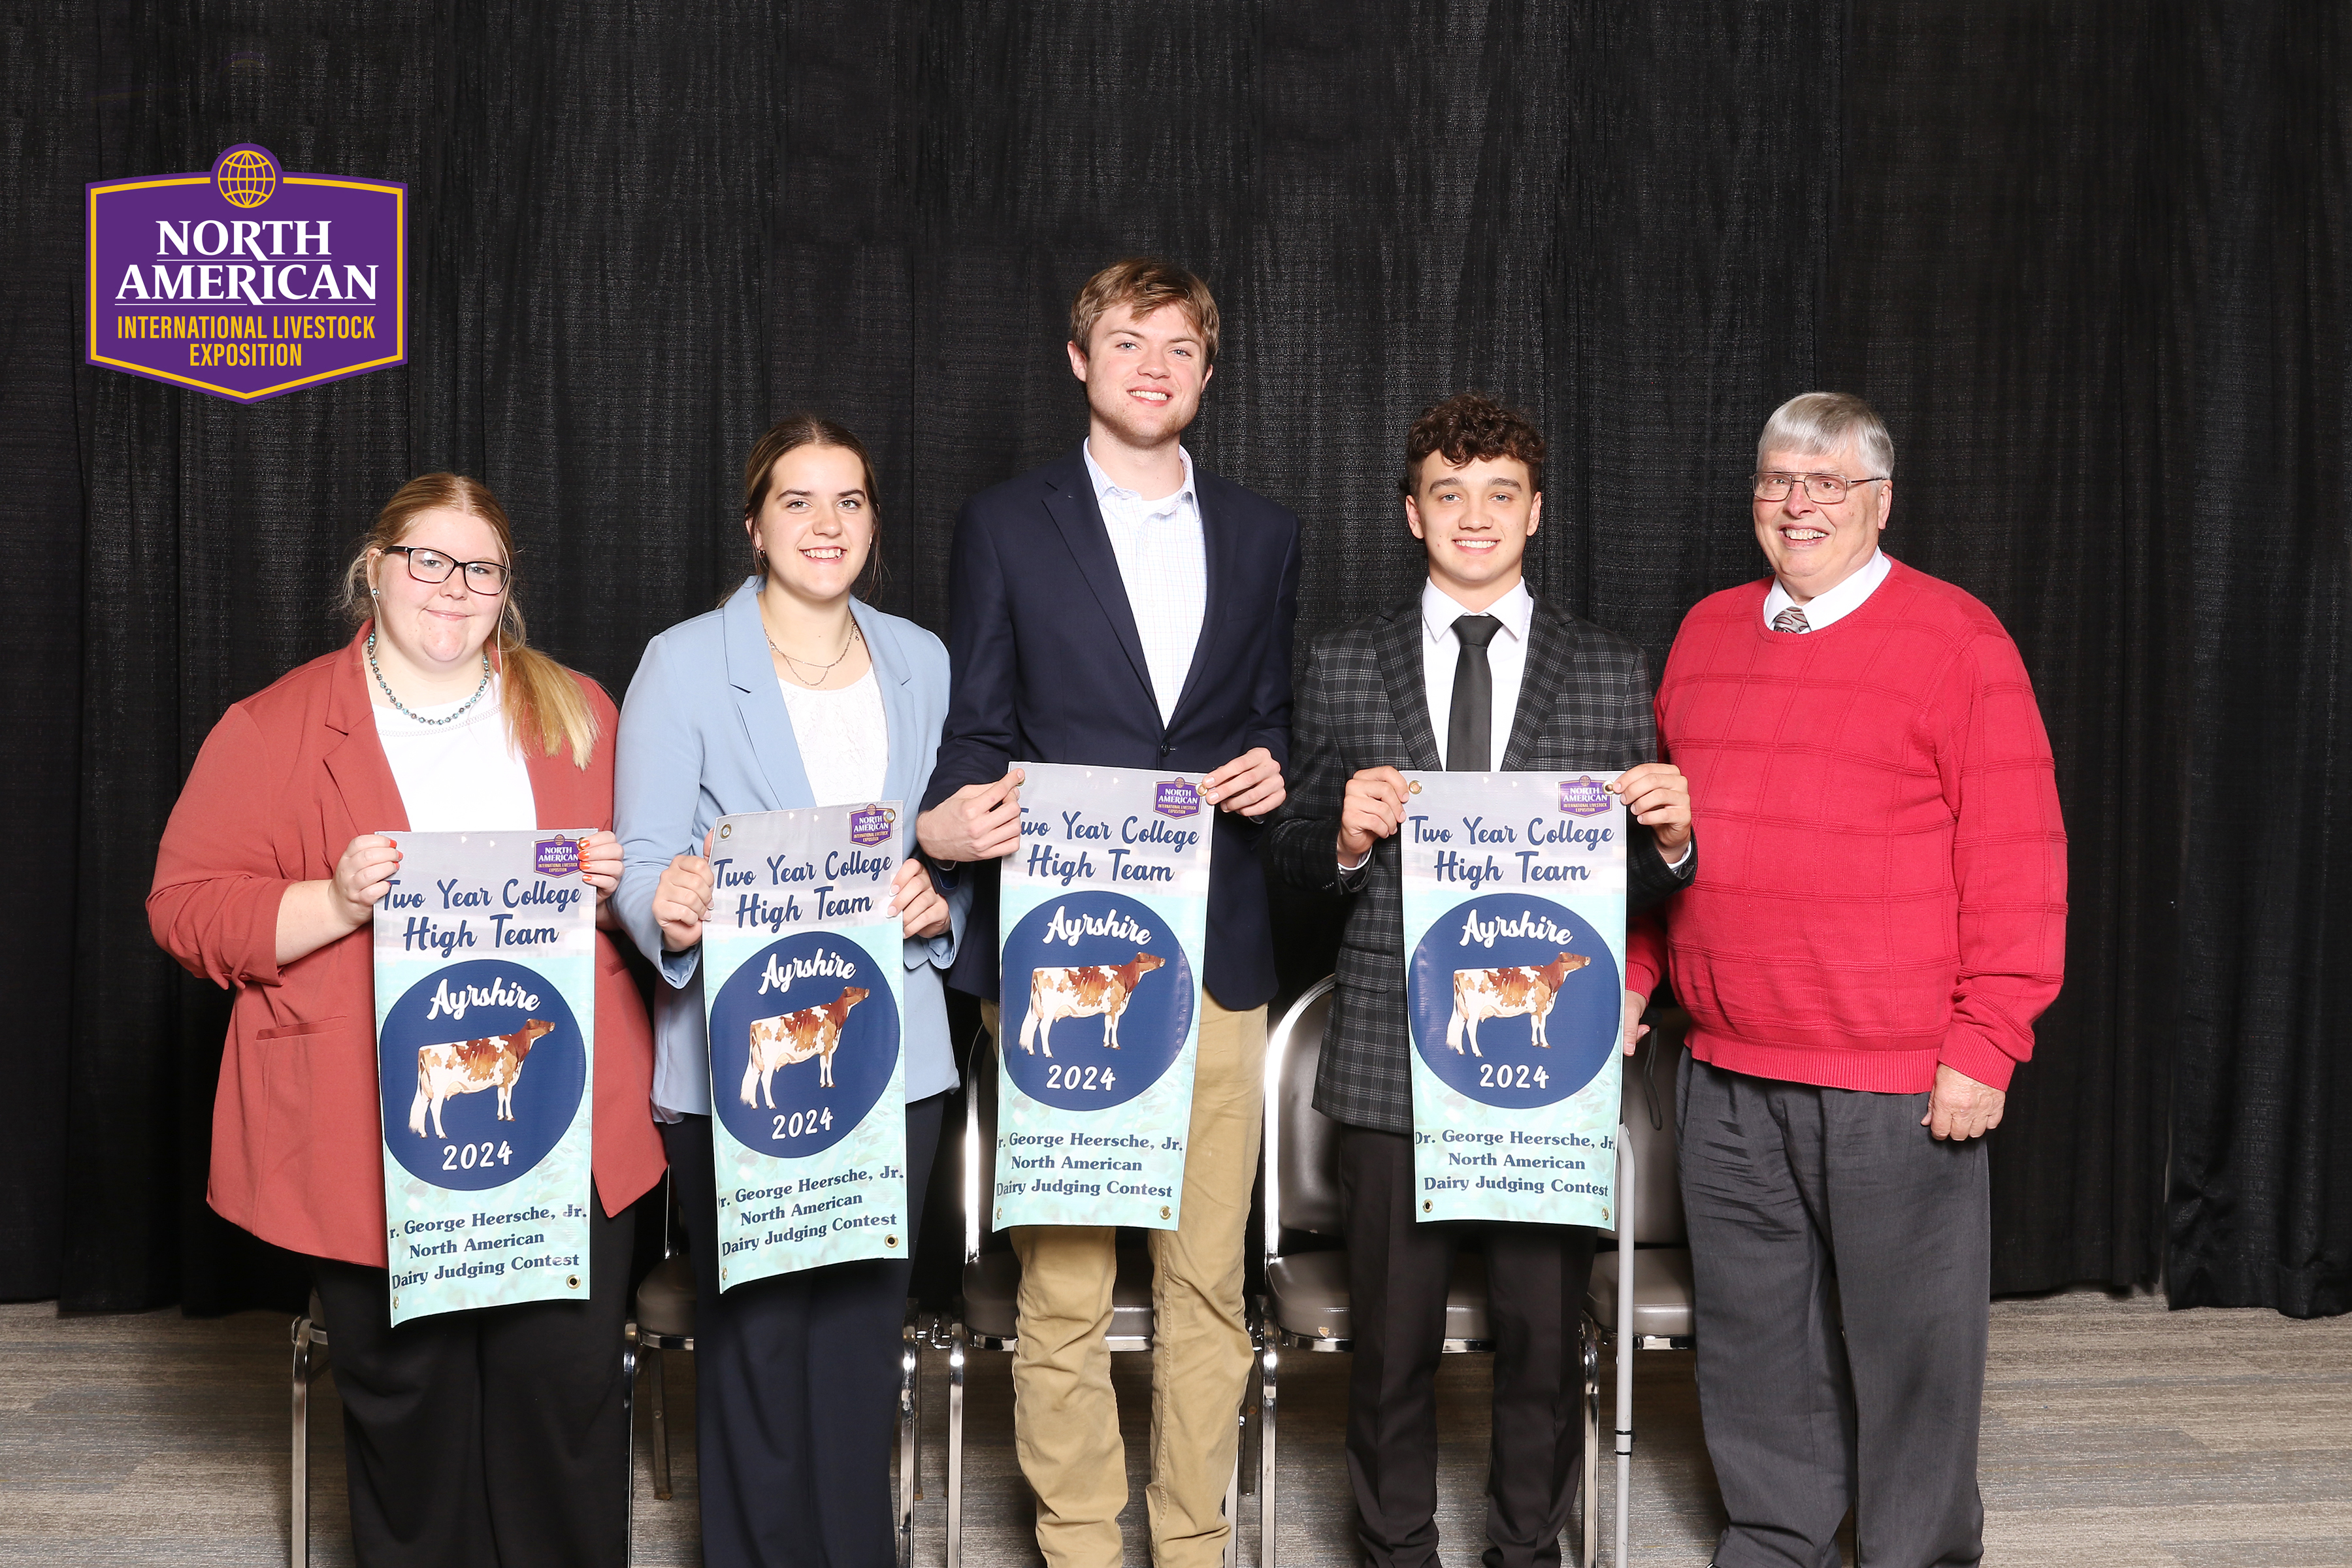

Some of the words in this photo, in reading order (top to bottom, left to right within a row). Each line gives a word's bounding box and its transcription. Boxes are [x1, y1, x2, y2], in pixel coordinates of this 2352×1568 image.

[1158, 795, 1198, 804] AMERICAN
[854, 823, 889, 832] AMERICAN
[859, 815, 882, 824] NORTH
[1062, 810, 1112, 840] Year
[1122, 815, 1200, 853] College
[1409, 815, 1453, 843] Two
[1463, 816, 1517, 845] Year
[1527, 817, 1614, 851] College
[713, 858, 757, 889] Two
[767, 855, 817, 885] Year
[825, 851, 893, 881] College
[1027, 844, 1096, 887] High
[1108, 848, 1175, 882] Team
[1434, 851, 1503, 889] High
[1515, 851, 1592, 883] Team
[383, 879, 426, 911] Two
[436, 879, 493, 909] Year
[502, 879, 582, 912] College
[736, 893, 803, 933] High
[814, 886, 874, 920] Team
[403, 917, 478, 958] High
[490, 913, 560, 948] Team
[1043, 906, 1152, 947] Ayrshire
[1459, 909, 1574, 949] Ayrshire
[758, 948, 857, 995] Ayrshire
[427, 977, 540, 1021] Ayrshire
[1045, 1064, 1116, 1092] 2024
[1479, 1063, 1550, 1089] 2024
[771, 1107, 834, 1141] 2024
[1416, 1132, 1435, 1145] Dr.
[1442, 1130, 1503, 1145] George
[1510, 1131, 1595, 1149] Heersche,
[1600, 1135, 1615, 1150] Jr.
[442, 1140, 514, 1171] 2024
[998, 1137, 1006, 1150] r.
[1009, 1132, 1064, 1148] George
[1070, 1133, 1154, 1151] Heersche,
[1161, 1136, 1183, 1151] Jr.
[1011, 1155, 1054, 1169] North
[1061, 1156, 1143, 1171] American
[1448, 1152, 1497, 1166] North
[1503, 1154, 1586, 1169] American
[719, 1197, 730, 1207] r.
[736, 1185, 792, 1202] George
[798, 1169, 874, 1194] Heersche,
[879, 1166, 904, 1179] Jr.
[997, 1180, 1026, 1196] Dairy
[1032, 1179, 1100, 1196] Judging
[1107, 1181, 1173, 1198] Contest
[1424, 1176, 1469, 1191] Dairy
[1475, 1176, 1544, 1194] Judging
[1551, 1179, 1609, 1197] Contest
[390, 1228, 400, 1239] r.
[404, 1218, 465, 1235] George
[472, 1206, 556, 1227] Heersche,
[563, 1204, 587, 1218] Jr.
[741, 1207, 785, 1226] North
[791, 1194, 862, 1217] American
[410, 1240, 457, 1259] North
[464, 1232, 544, 1252] American
[722, 1237, 759, 1256] Dairy
[764, 1223, 827, 1245] Judging
[832, 1213, 897, 1231] Contest
[392, 1269, 429, 1290] Dairy
[434, 1261, 505, 1279] Judging
[512, 1254, 580, 1269] Contest
